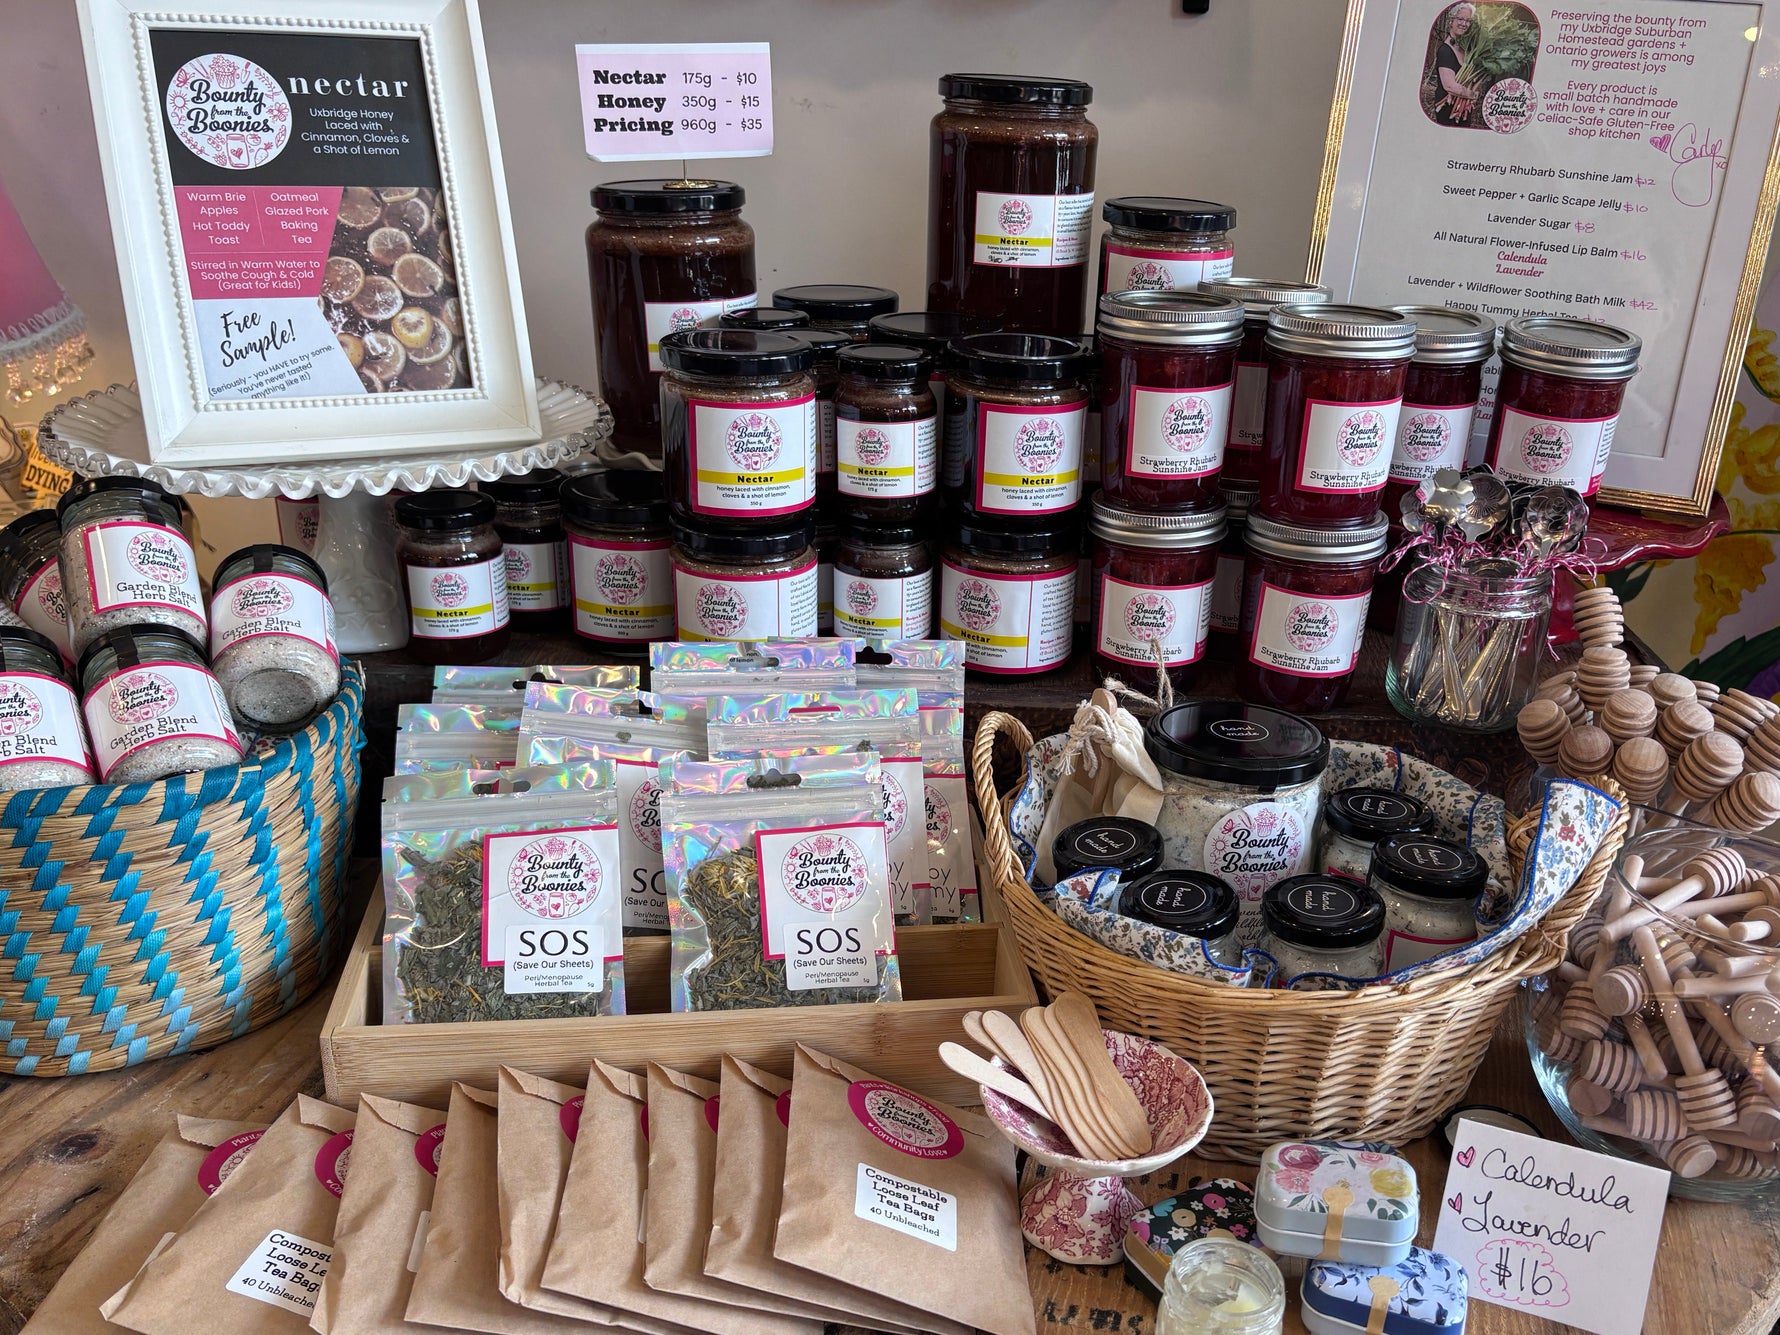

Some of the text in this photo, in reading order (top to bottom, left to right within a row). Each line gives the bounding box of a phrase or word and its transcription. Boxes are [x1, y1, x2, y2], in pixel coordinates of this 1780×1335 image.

[1551, 10, 1706, 28] Preserving the bounty from
[1560, 23, 1692, 38] my Uxbridge Suburban
[1558, 34, 1624, 47] Homestead
[1627, 37, 1677, 50] gardens
[1546, 45, 1694, 65] Ontario growers is among
[1571, 57, 1666, 74] my greatest joys
[288, 73, 408, 98] nectar
[593, 70, 666, 85] Nectar
[682, 72, 712, 88] 175g
[737, 72, 757, 85] $10
[1567, 80, 1658, 96] Every product is
[189, 79, 266, 115] Bounty
[598, 94, 666, 113] Honey
[682, 96, 716, 111] 350g
[741, 95, 759, 109] $15
[1543, 91, 1678, 108] small batch handmade
[211, 105, 250, 118] from the
[309, 108, 393, 121] Uxbridge Honey
[1546, 102, 1570, 113] with
[1572, 103, 1596, 114] love
[1608, 107, 1634, 116] care
[1638, 107, 1648, 117] in
[1651, 110, 1671, 119] our
[187, 107, 274, 133] Boonies
[325, 120, 383, 130] Laced with
[594, 118, 674, 135] Pricing
[681, 119, 716, 133] 960g
[741, 118, 762, 131] $35
[1537, 112, 1674, 132] Celiac-Safe Gluten-Free
[301, 132, 410, 143] Cinnamon, Cloves &
[1568, 127, 1640, 140] shop kitchen
[323, 145, 348, 154] Shot
[350, 145, 361, 154] of
[363, 145, 400, 155] Lemon
[1447, 160, 1633, 184] Strawberry Rhubarb Sunshine Jam
[1635, 176, 1656, 188] $12
[187, 192, 246, 201] Warm Brie
[270, 193, 319, 202] Oatmeal
[1443, 184, 1476, 197] Sweet
[1478, 188, 1516, 202] Pepper
[1528, 192, 1559, 204] Garlic
[1562, 196, 1596, 208] Scape
[1598, 198, 1622, 212] Jelly
[200, 206, 238, 217] Apples
[265, 206, 329, 216] Glazed Pork
[1624, 202, 1648, 214] $10
[193, 221, 250, 233] Hot Toddy
[281, 221, 318, 232] Baking
[1488, 213, 1570, 230] Lavender Sugar
[1575, 220, 1595, 234] $8
[208, 235, 240, 244] Toast
[292, 235, 312, 244] Tea
[1434, 231, 1618, 258] All Natural Flower-Infused Lip Balm
[1498, 251, 1548, 265] Calendula
[1620, 249, 1646, 261] $16
[191, 260, 320, 270] Stirred in Warm Water to
[1496, 264, 1544, 278] Lavender
[201, 270, 314, 282] Soothe Cough & Cold
[218, 279, 301, 290] (Great for Kids!)
[1408, 275, 1455, 289] Lavender
[1466, 282, 1522, 296] Wildflower
[1525, 288, 1573, 304] Soothing
[1575, 292, 1600, 305] Bath
[1603, 295, 1626, 307] Milk
[1630, 298, 1658, 312] $42
[220, 311, 261, 338] Free
[220, 319, 297, 368] Sample!
[25, 463, 70, 495] DYING
[738, 475, 774, 484] Nectar
[1021, 477, 1055, 486] Nectar
[1261, 647, 1306, 665] Strawberry
[1271, 658, 1310, 670] Sunshine
[110, 715, 198, 750] Garden Blend
[123, 724, 187, 750] Herb Salt
[1231, 827, 1289, 856] Bounty
[528, 853, 583, 879] Bounty
[1220, 852, 1288, 874] Boonies
[542, 870, 560, 881] from
[521, 876, 587, 895] Boonies
[519, 930, 589, 957] SOS
[513, 959, 594, 970] (Save Our Sheets)
[524, 974, 583, 982] Peri/Menopause
[865, 1168, 948, 1203] Compostable
[1481, 1148, 1634, 1213] Calendula
[873, 1181, 940, 1212] Loose Leaf
[877, 1193, 934, 1222] Tea Bags
[870, 1207, 940, 1237] 40 Unbleached
[1462, 1191, 1605, 1252] Lavender
[1490, 1247, 1552, 1296] $16
